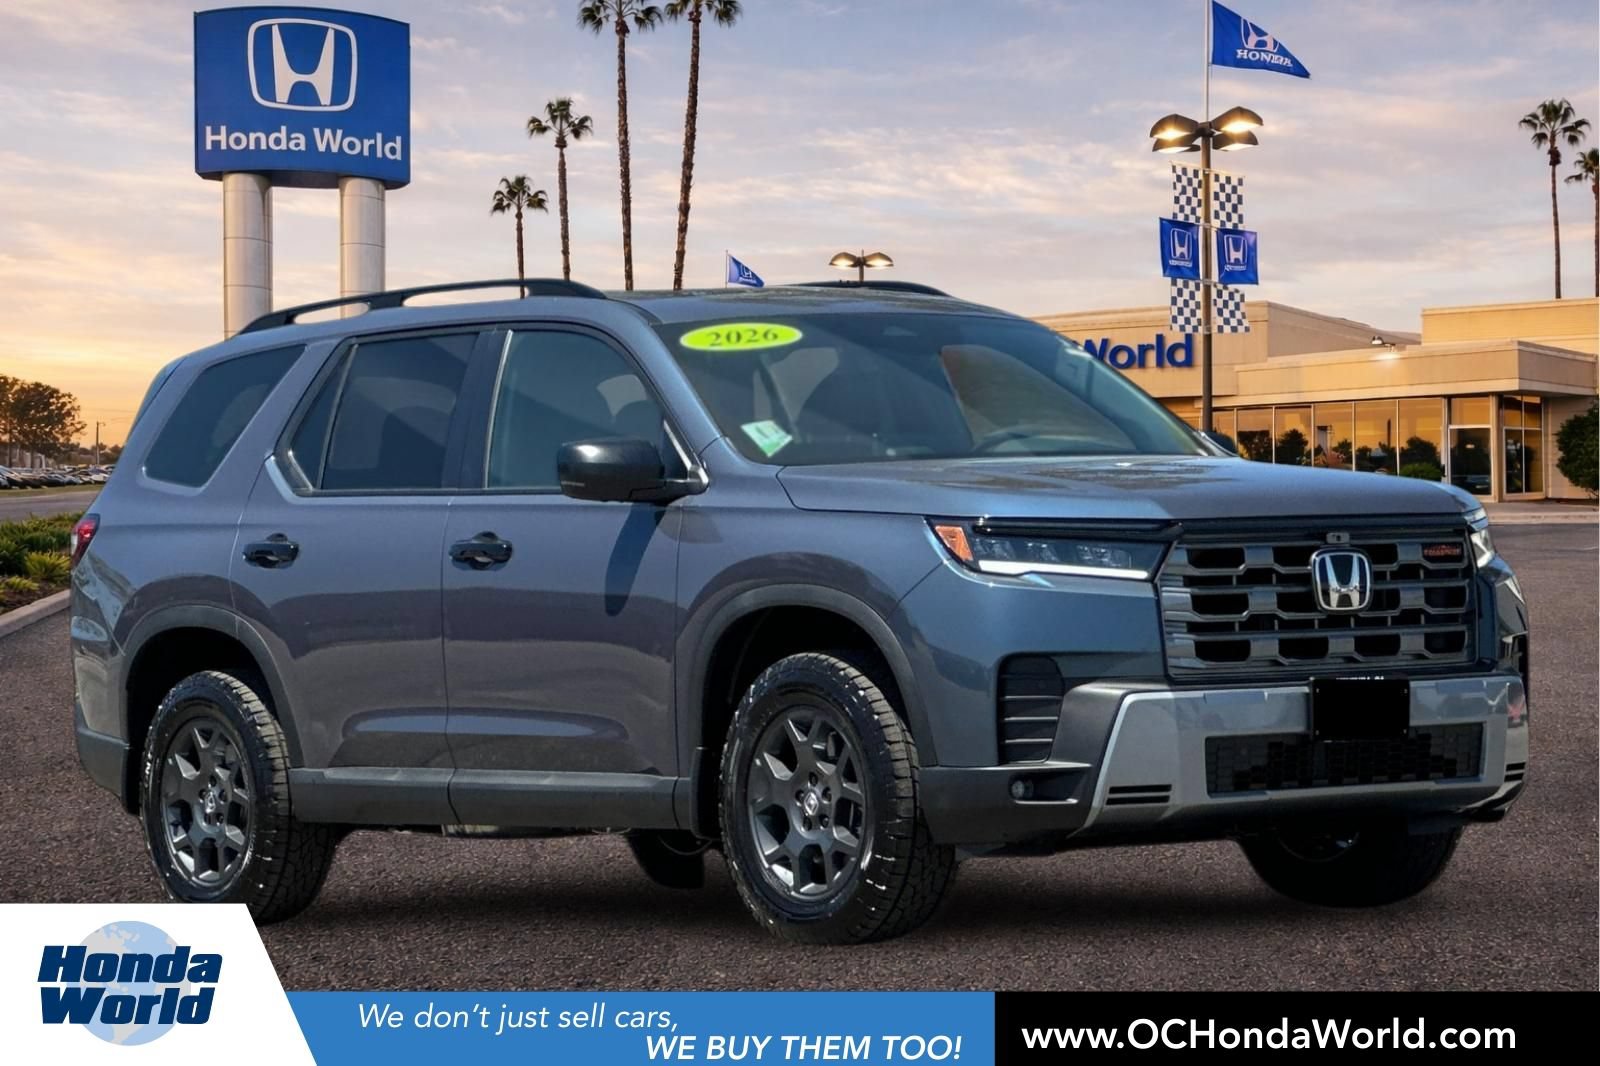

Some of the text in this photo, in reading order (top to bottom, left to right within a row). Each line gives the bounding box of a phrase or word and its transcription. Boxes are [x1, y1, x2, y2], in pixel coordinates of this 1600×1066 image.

[205, 125, 402, 160] Honda World
[706, 328, 779, 347] 2026
